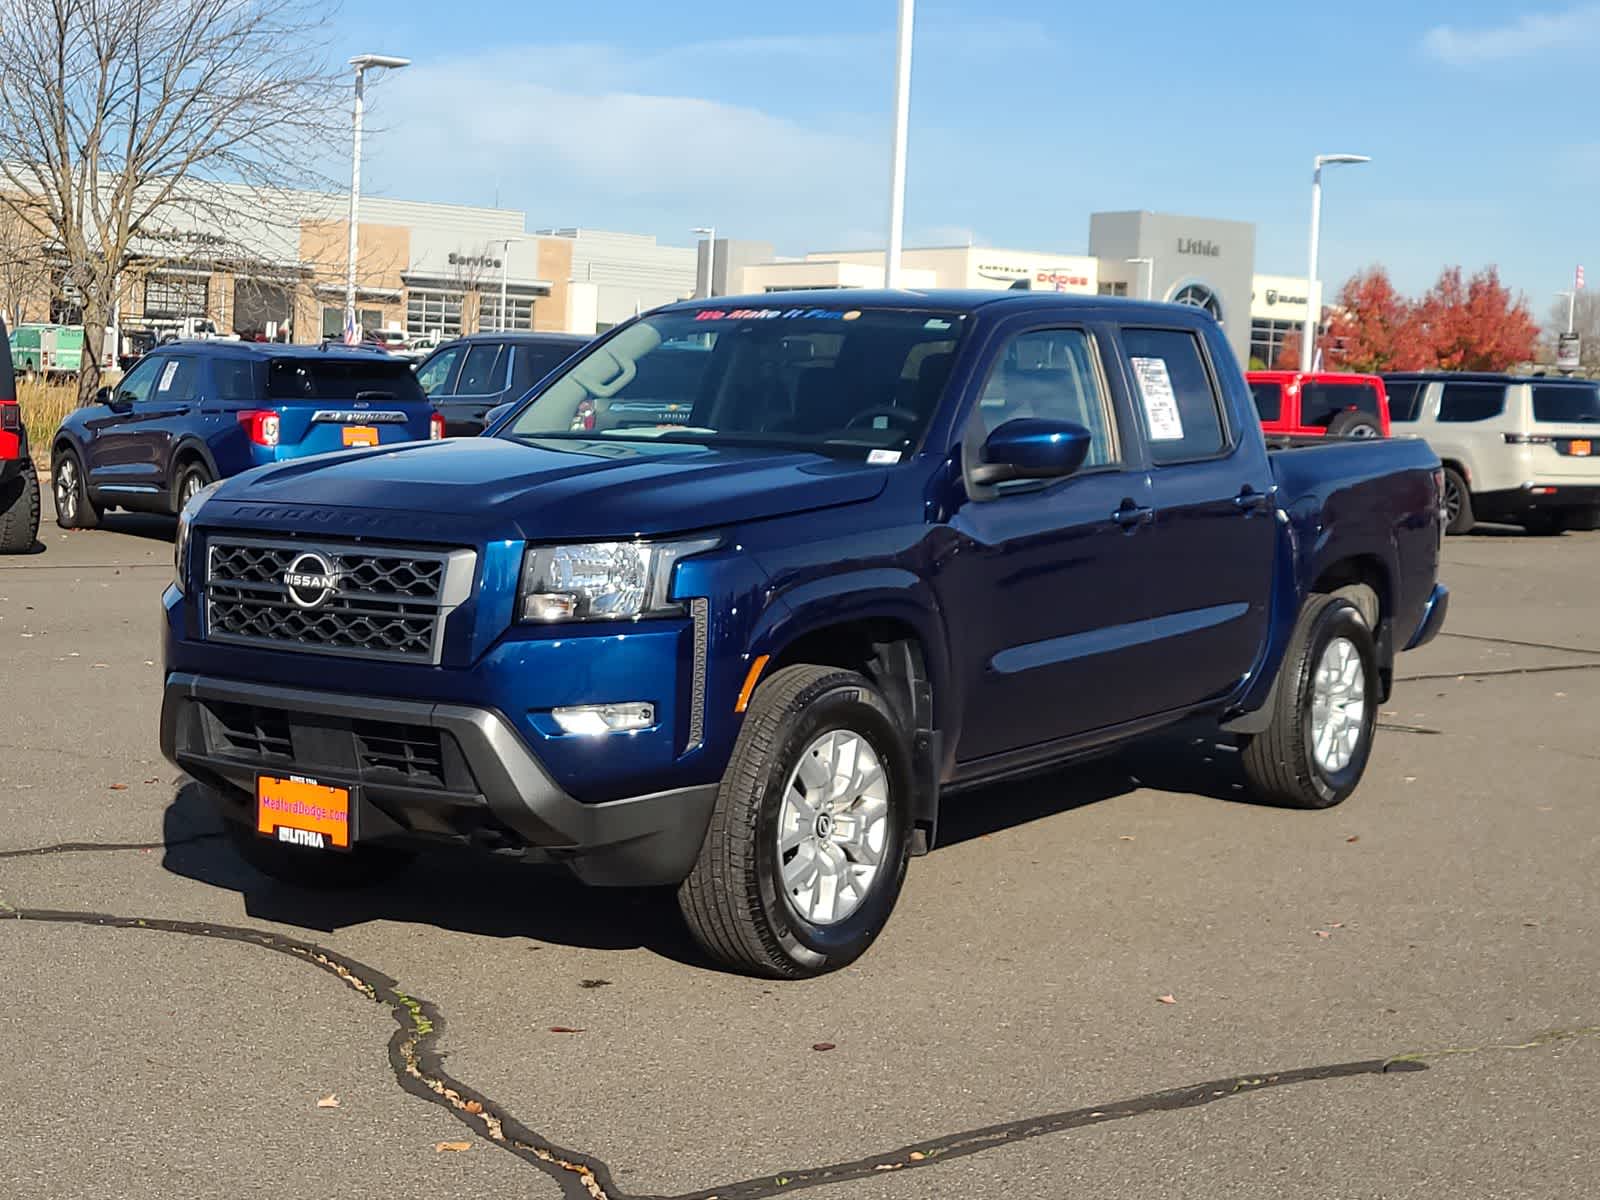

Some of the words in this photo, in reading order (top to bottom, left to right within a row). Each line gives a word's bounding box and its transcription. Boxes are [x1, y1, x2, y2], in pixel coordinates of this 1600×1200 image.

[1178, 237, 1220, 257] Lithia
[448, 253, 501, 268] Service
[978, 264, 1029, 274] CHRYSLER
[1037, 273, 1089, 286] DODGE
[726, 309, 781, 320] Make
[283, 573, 333, 589] NISSAN
[290, 828, 325, 848] LITHIA
